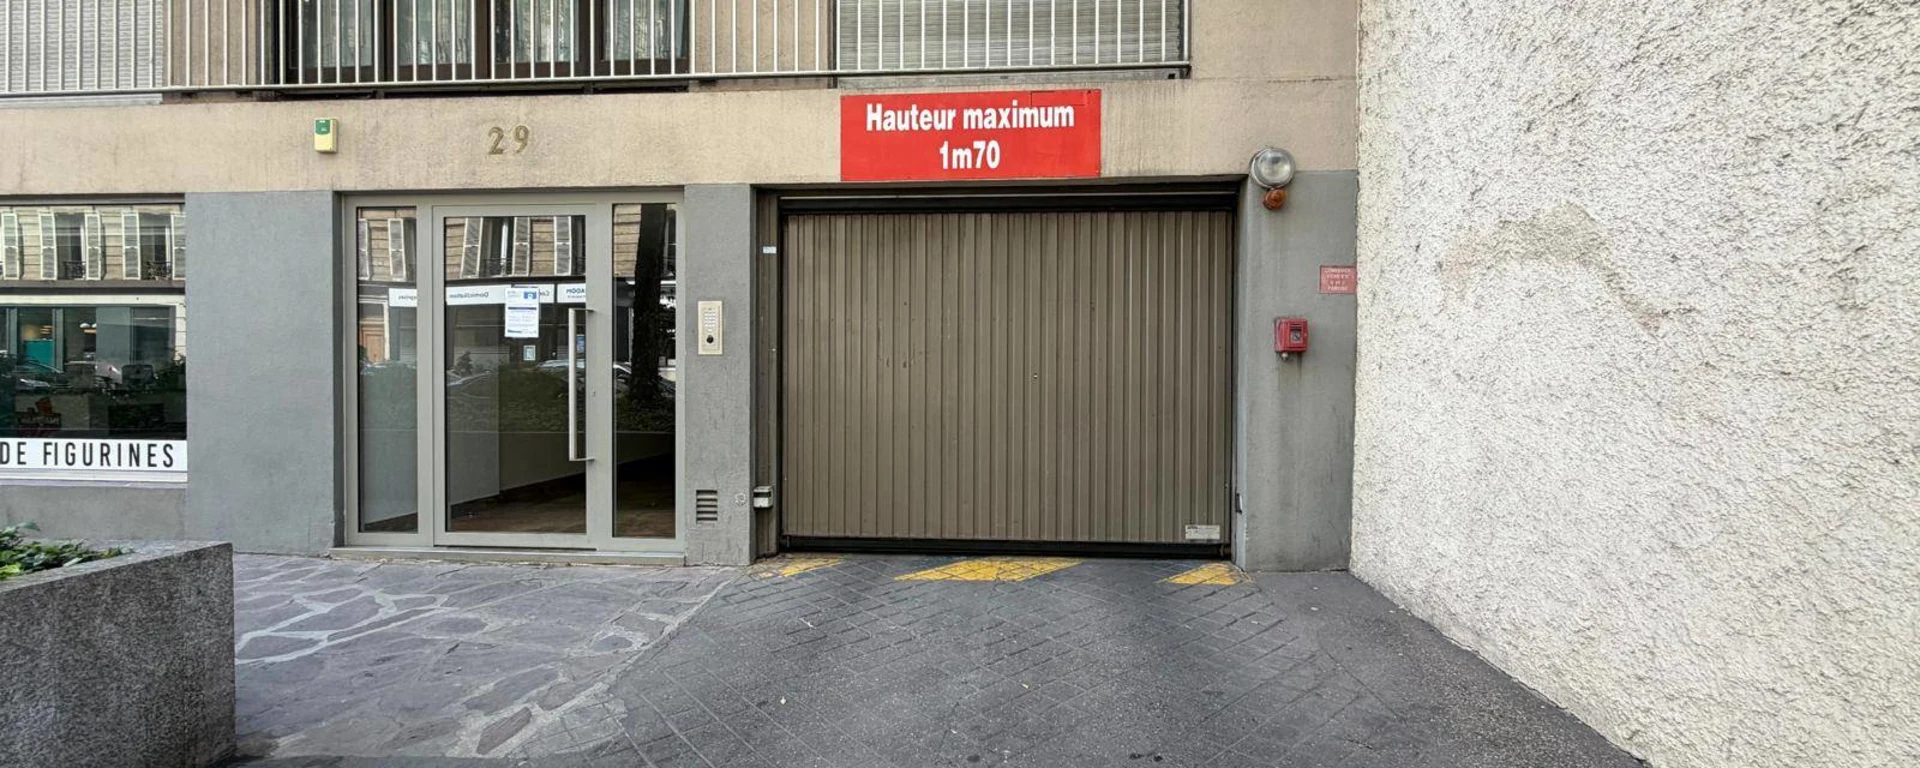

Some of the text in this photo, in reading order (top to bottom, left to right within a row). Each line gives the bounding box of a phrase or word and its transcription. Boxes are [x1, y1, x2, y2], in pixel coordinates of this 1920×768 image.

[866, 100, 1075, 132] Hauteur maximum
[488, 125, 529, 155] 29
[939, 140, 1000, 169] 1m70
[0, 441, 174, 468] DE FIGURINES
